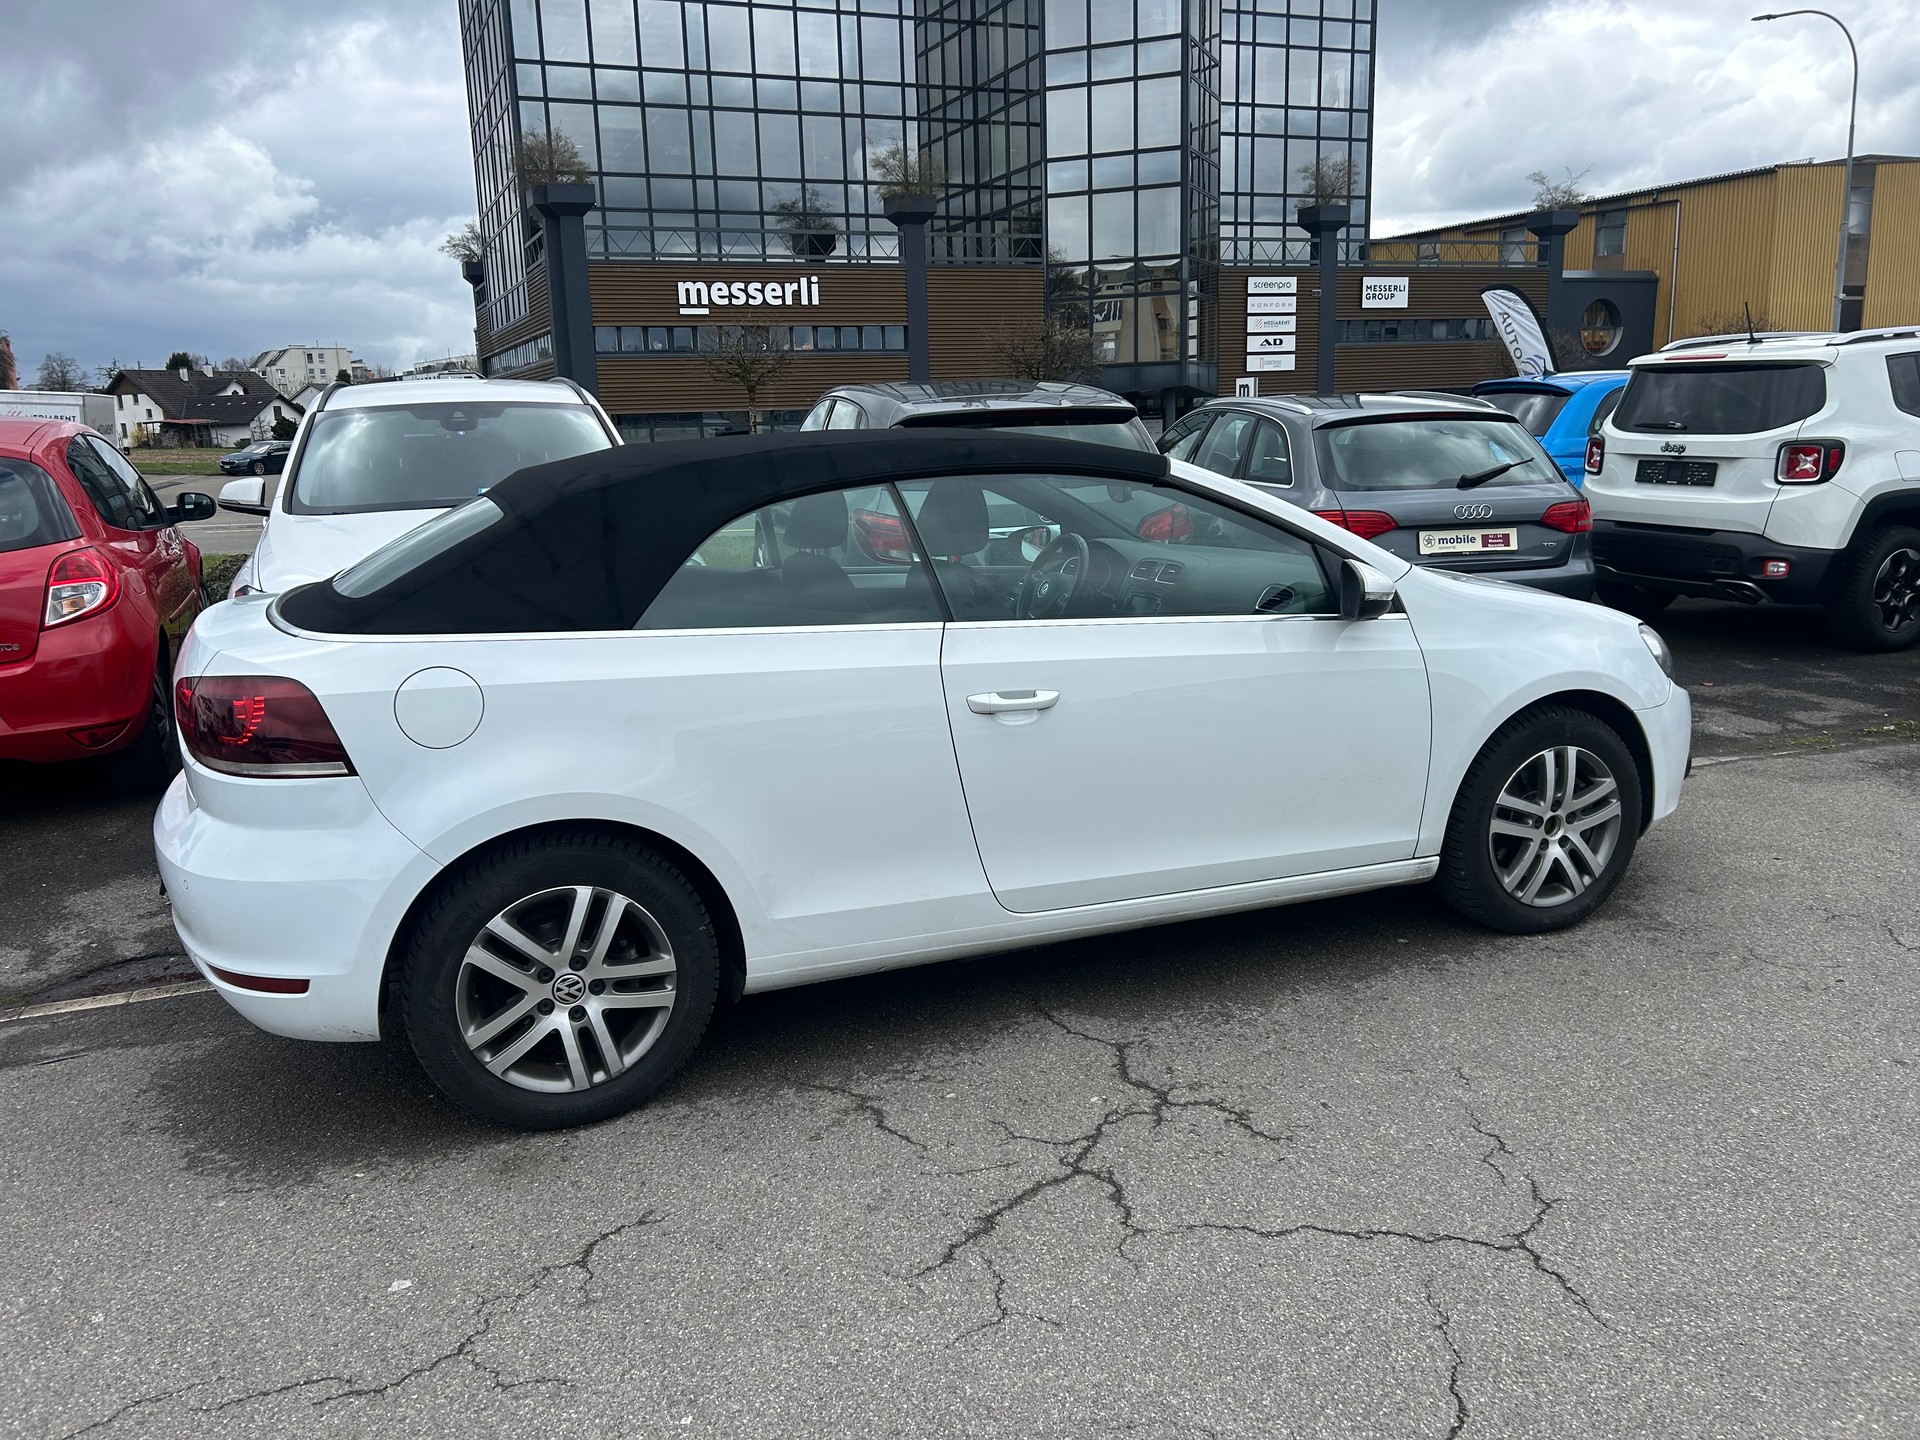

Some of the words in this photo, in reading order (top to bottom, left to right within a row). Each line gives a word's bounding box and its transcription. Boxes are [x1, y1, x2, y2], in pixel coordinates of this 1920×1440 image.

[1253, 281, 1292, 290] screenpro
[1365, 284, 1406, 292] MESSERLI
[677, 275, 820, 306] messerli
[1365, 292, 1395, 301] GROUP
[1498, 311, 1523, 360] AUTO
[1260, 338, 1284, 346] AD
[25, 414, 76, 422] EDIARENT
[1660, 441, 1687, 455] Jeep
[1438, 534, 1477, 545] mobile
